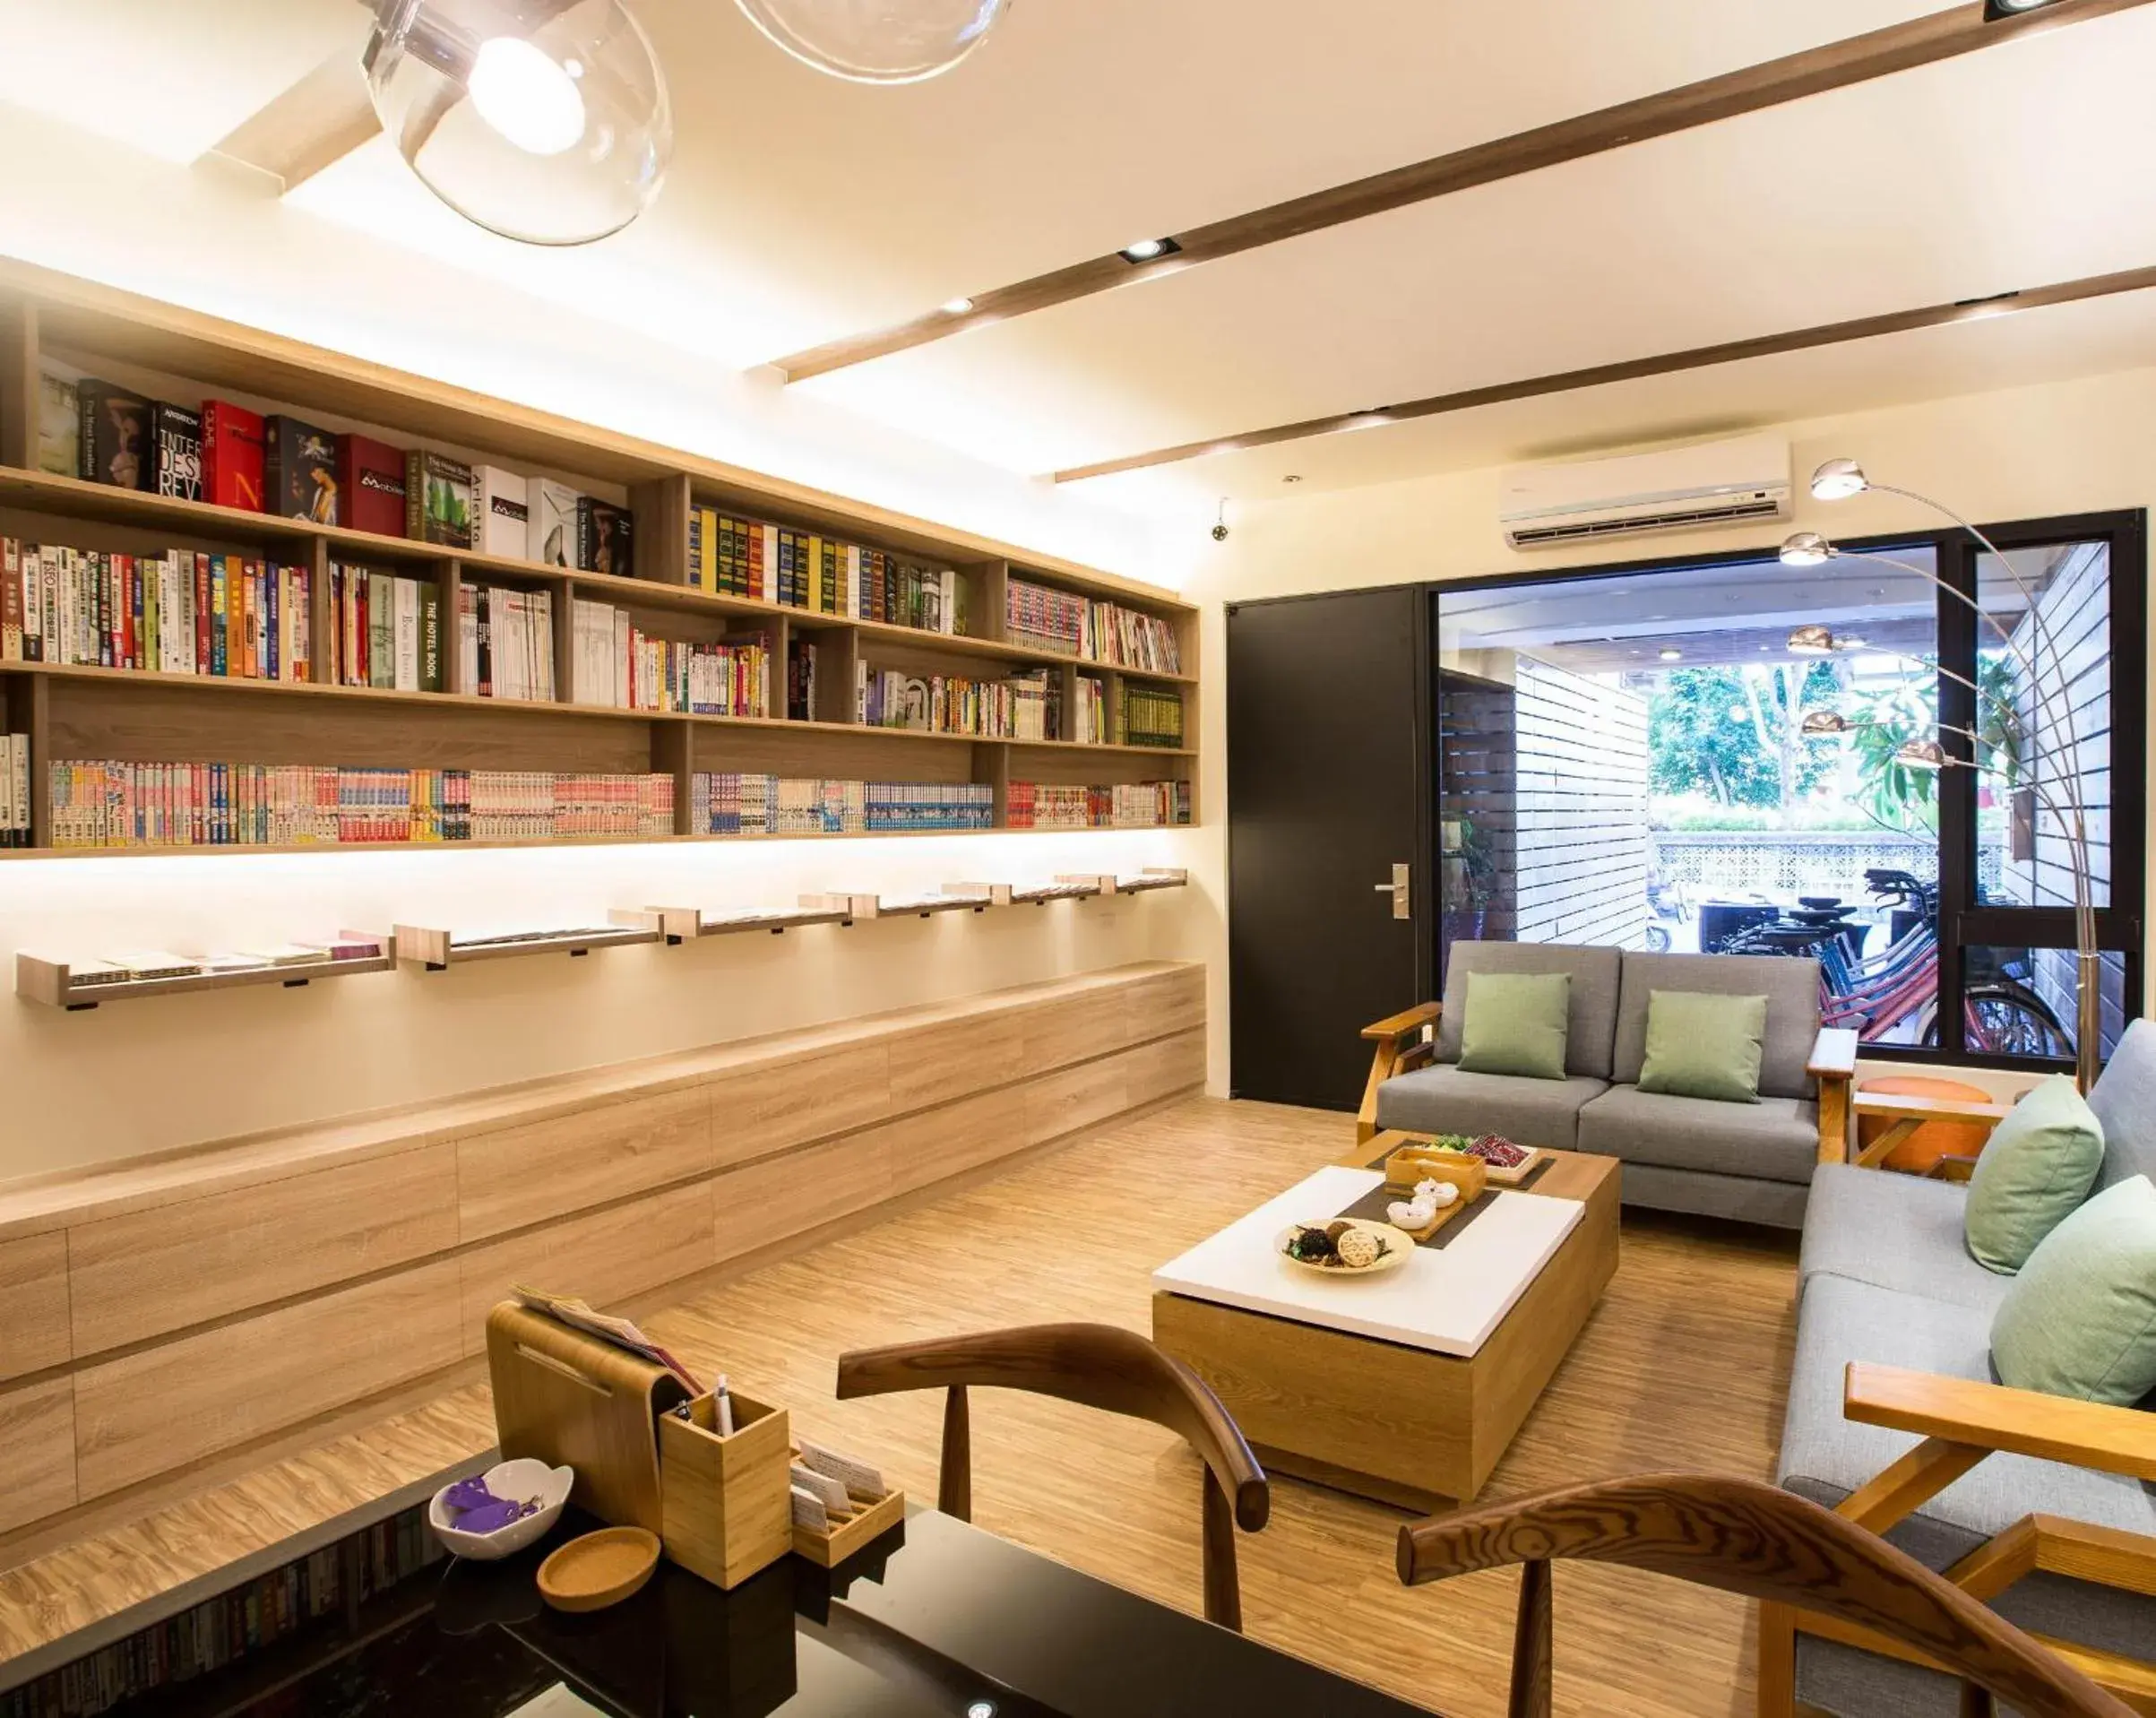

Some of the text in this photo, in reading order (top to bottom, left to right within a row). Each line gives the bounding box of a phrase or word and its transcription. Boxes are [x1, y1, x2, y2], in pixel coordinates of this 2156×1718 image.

[233, 471, 262, 510] N
[426, 601, 436, 678] THE HOTEL BOOK
